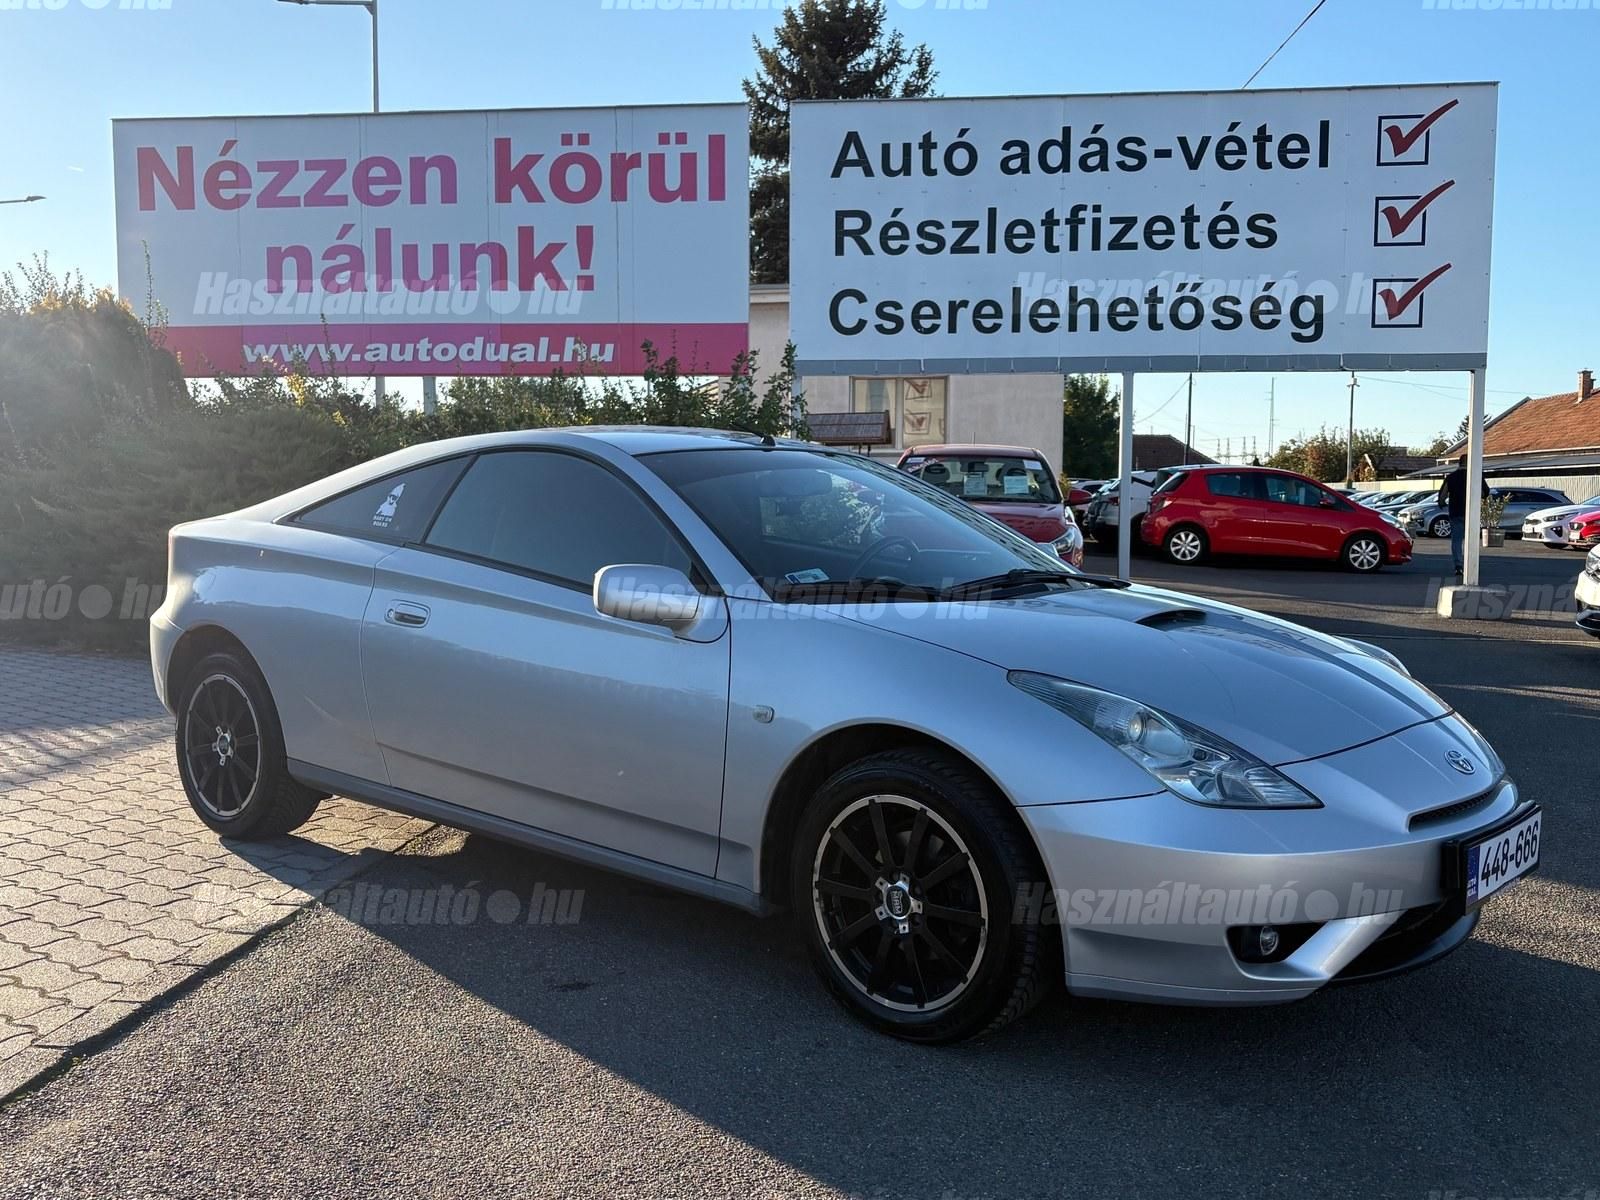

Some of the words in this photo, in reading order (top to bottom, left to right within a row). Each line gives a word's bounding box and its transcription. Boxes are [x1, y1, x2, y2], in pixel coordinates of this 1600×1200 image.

[136, 139, 458, 211] Nézzen
[494, 132, 726, 205] körül
[830, 126, 979, 180] Autó
[1000, 119, 1330, 175] adás-vétel
[265, 223, 595, 294] nálunk!
[834, 201, 1278, 257] Részletfizetés
[829, 281, 1325, 343] Cserelehetőség
[243, 335, 614, 363] www.autodual.hu
[1481, 820, 1538, 887] 448-666
